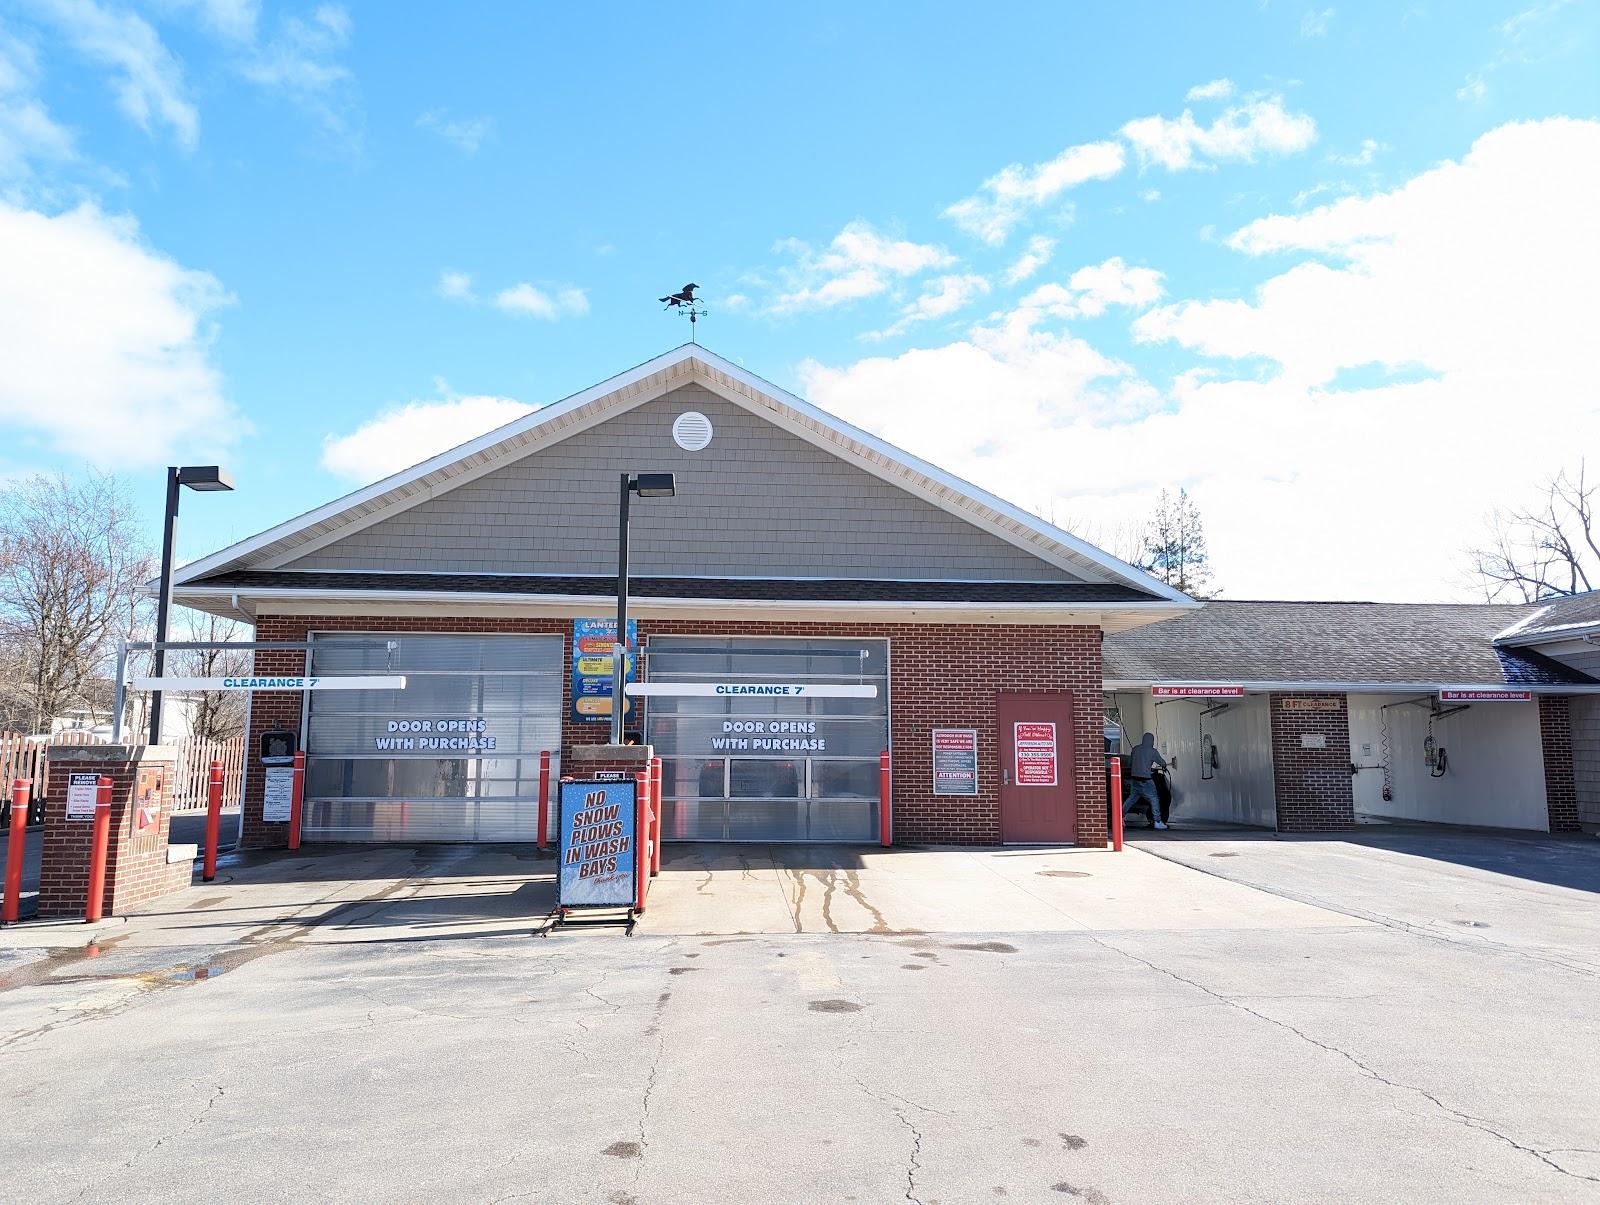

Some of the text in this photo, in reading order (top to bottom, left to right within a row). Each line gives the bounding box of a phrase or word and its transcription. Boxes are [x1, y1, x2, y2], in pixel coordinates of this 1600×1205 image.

[223, 678, 320, 688] CLEARANCE 7'
[716, 686, 805, 695] CLEARANCE 7'
[1158, 687, 1238, 695] Bar is at clearance level
[1447, 691, 1525, 699] Bar is at clearance level
[1285, 700, 1291, 709] 8
[1292, 700, 1302, 709] FT
[387, 720, 486, 732] DOOR OPENS
[722, 721, 816, 734] DOOR OPENS
[375, 737, 497, 750] WITH PURCHASE
[711, 737, 826, 751] WITH PURCHASE
[585, 790, 607, 809] NO
[573, 804, 620, 829] SNOW
[570, 821, 623, 847] PLOWS
[564, 836, 630, 865] IN WASH
[579, 856, 617, 880] BAYS
